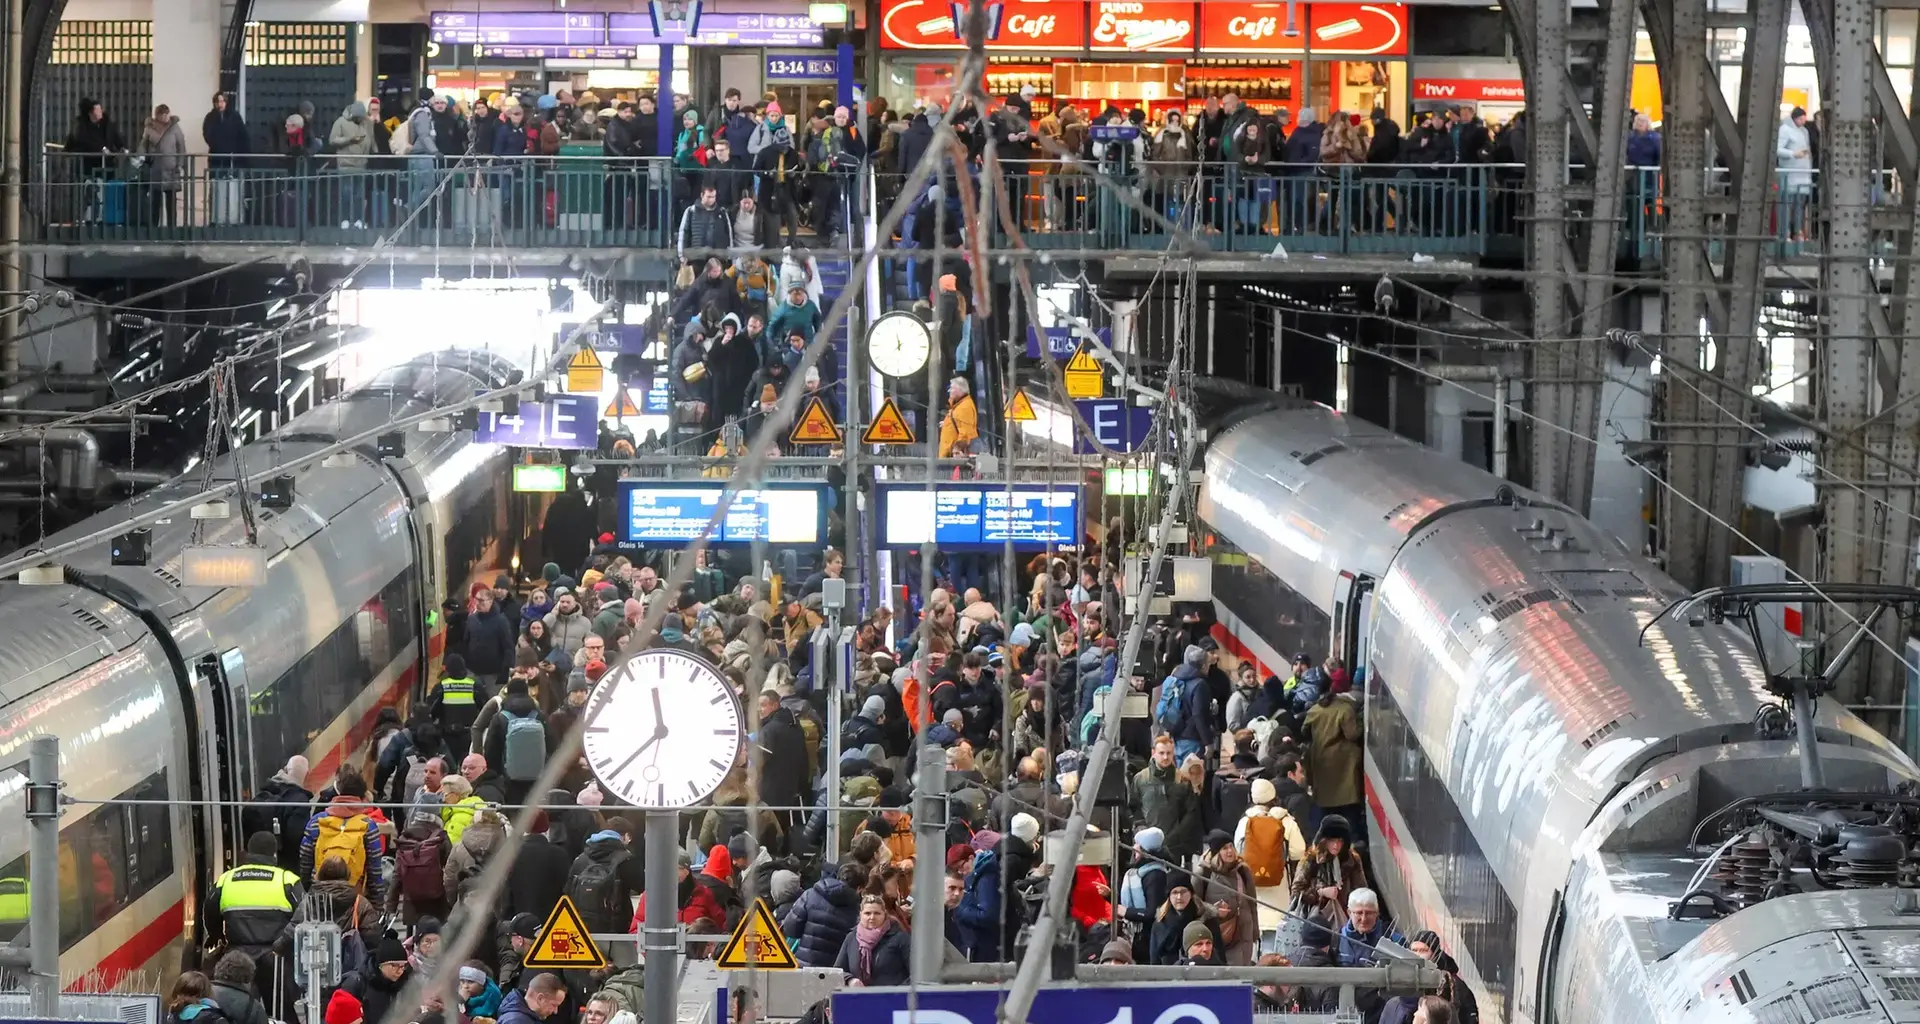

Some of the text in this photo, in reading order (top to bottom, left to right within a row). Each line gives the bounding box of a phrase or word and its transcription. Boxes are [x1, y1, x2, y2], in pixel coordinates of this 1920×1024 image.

[1100, 2, 1144, 14] PUNTO
[1008, 14, 1056, 38] Café
[1228, 17, 1277, 40] Café
[769, 61, 805, 74] 13-14
[1425, 83, 1456, 96] hvv
[551, 398, 577, 440] E
[1094, 404, 1120, 445] E
[618, 541, 645, 549] Gleis 14
[1058, 543, 1076, 552] Gleis
